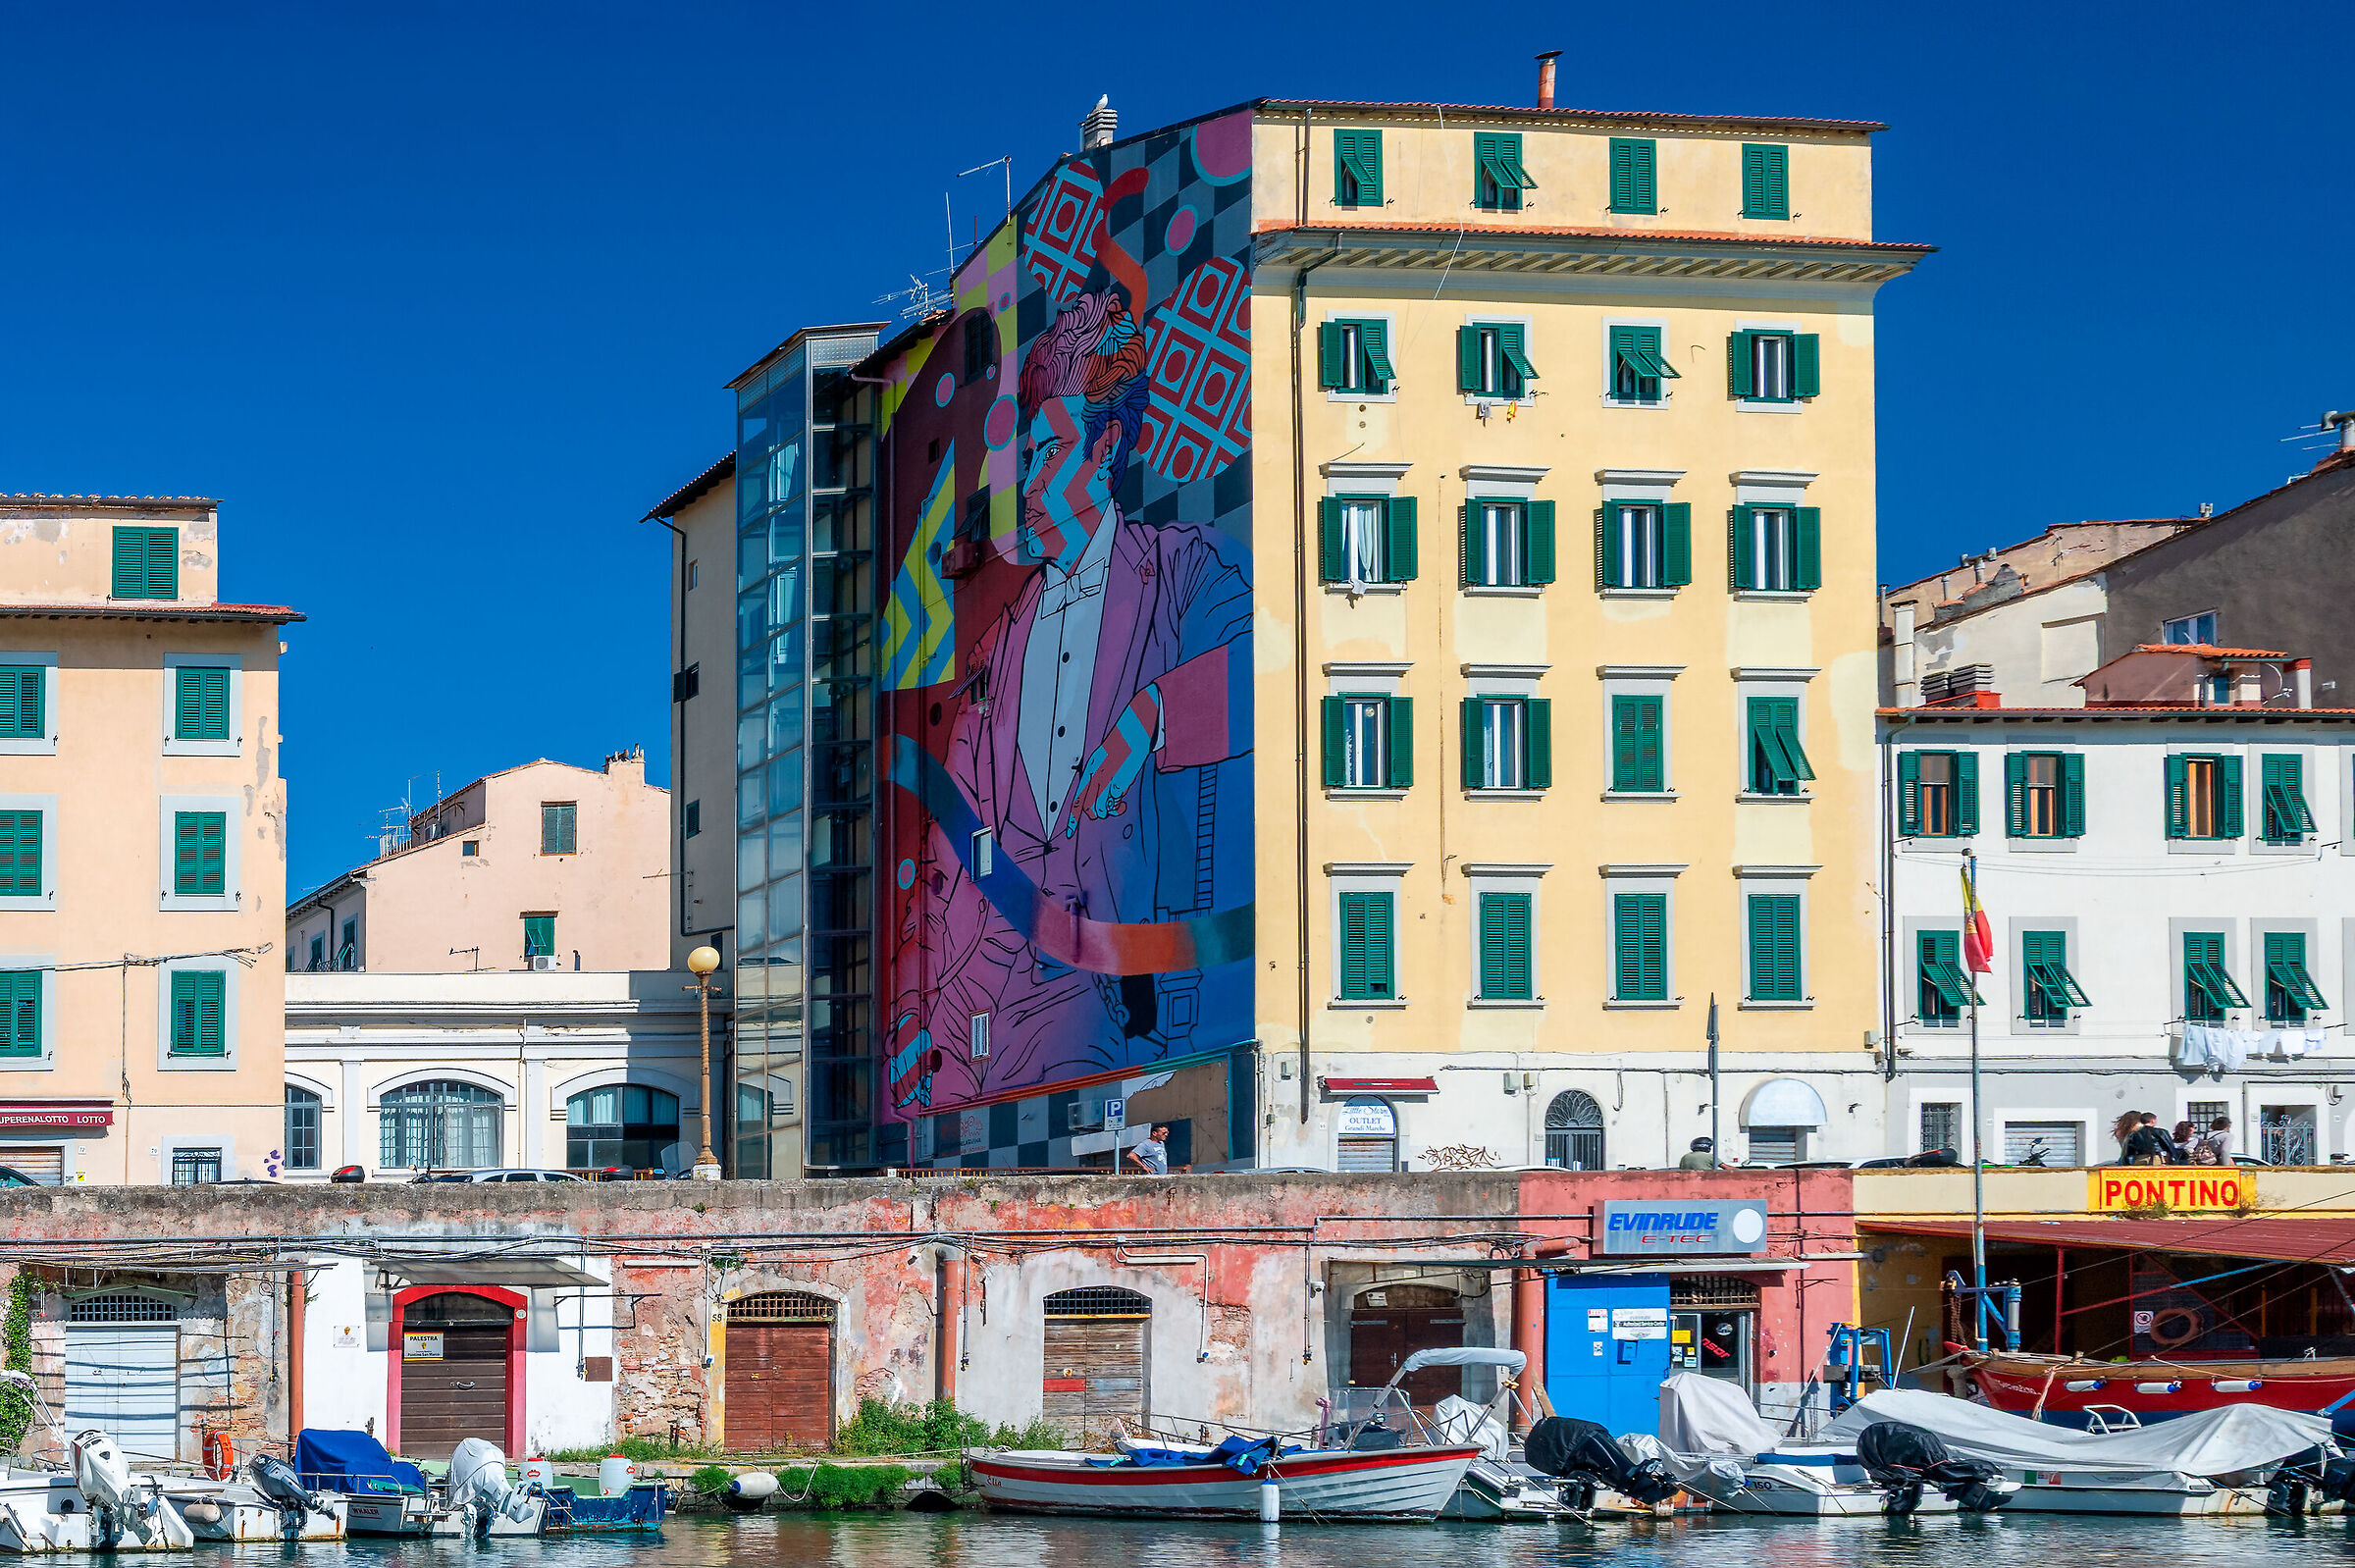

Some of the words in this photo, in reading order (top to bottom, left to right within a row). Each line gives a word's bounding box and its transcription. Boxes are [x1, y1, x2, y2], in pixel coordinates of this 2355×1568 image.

[1110, 1101, 1122, 1116] P
[77, 1115, 106, 1124] LOTTO
[2106, 1179, 2238, 1207] PONTINO
[1607, 1212, 1719, 1231] EVINRUDE
[1642, 1234, 1712, 1243] E-TEC
